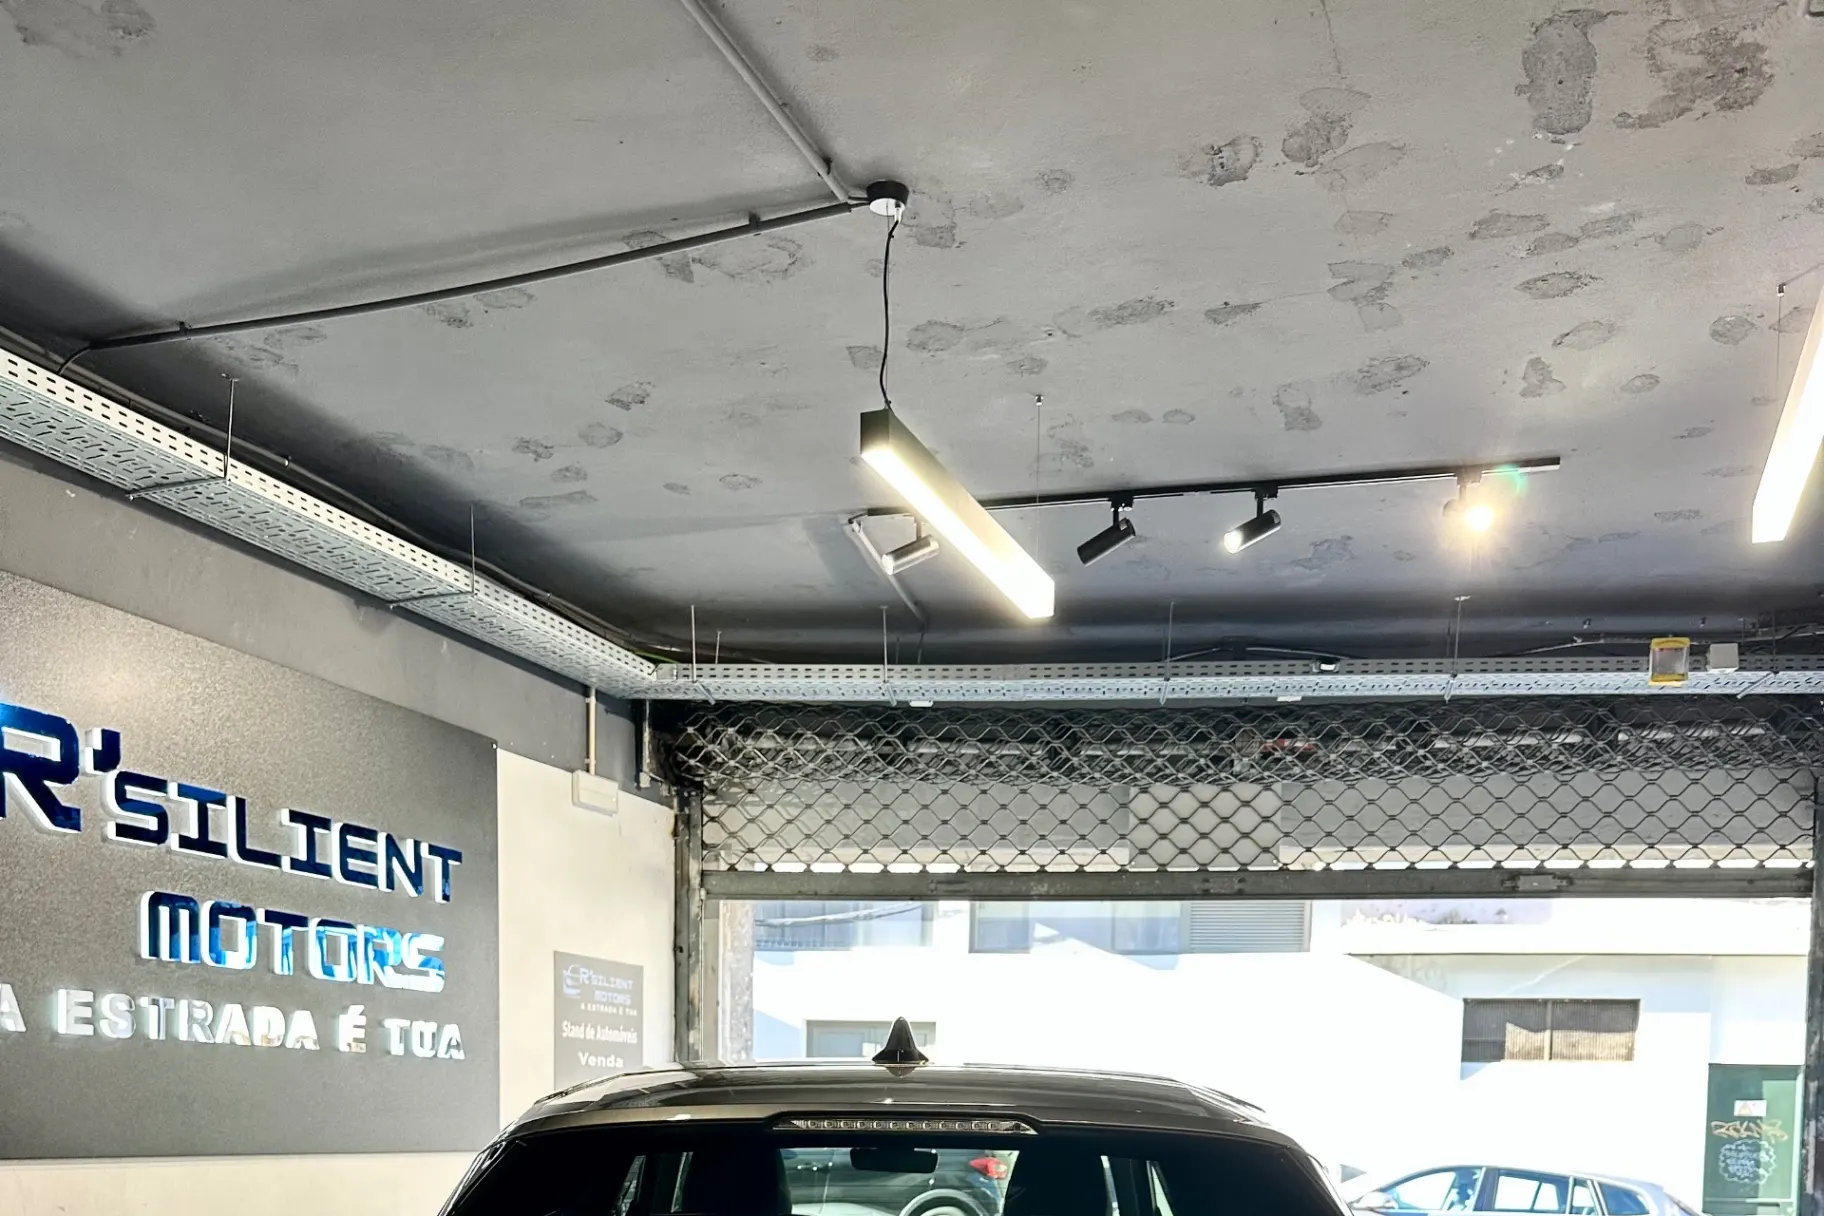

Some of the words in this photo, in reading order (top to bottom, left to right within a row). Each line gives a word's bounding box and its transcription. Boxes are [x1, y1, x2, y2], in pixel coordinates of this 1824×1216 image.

[0, 703, 462, 904] R'SILIENT
[140, 890, 446, 993] MOTORS
[57, 988, 320, 1051] ESTRADA
[337, 1004, 367, 1053] É
[384, 1018, 466, 1060] TUA
[562, 1020, 585, 1040] Stand
[585, 1023, 595, 1040] de
[578, 1051, 624, 1068] Venda
